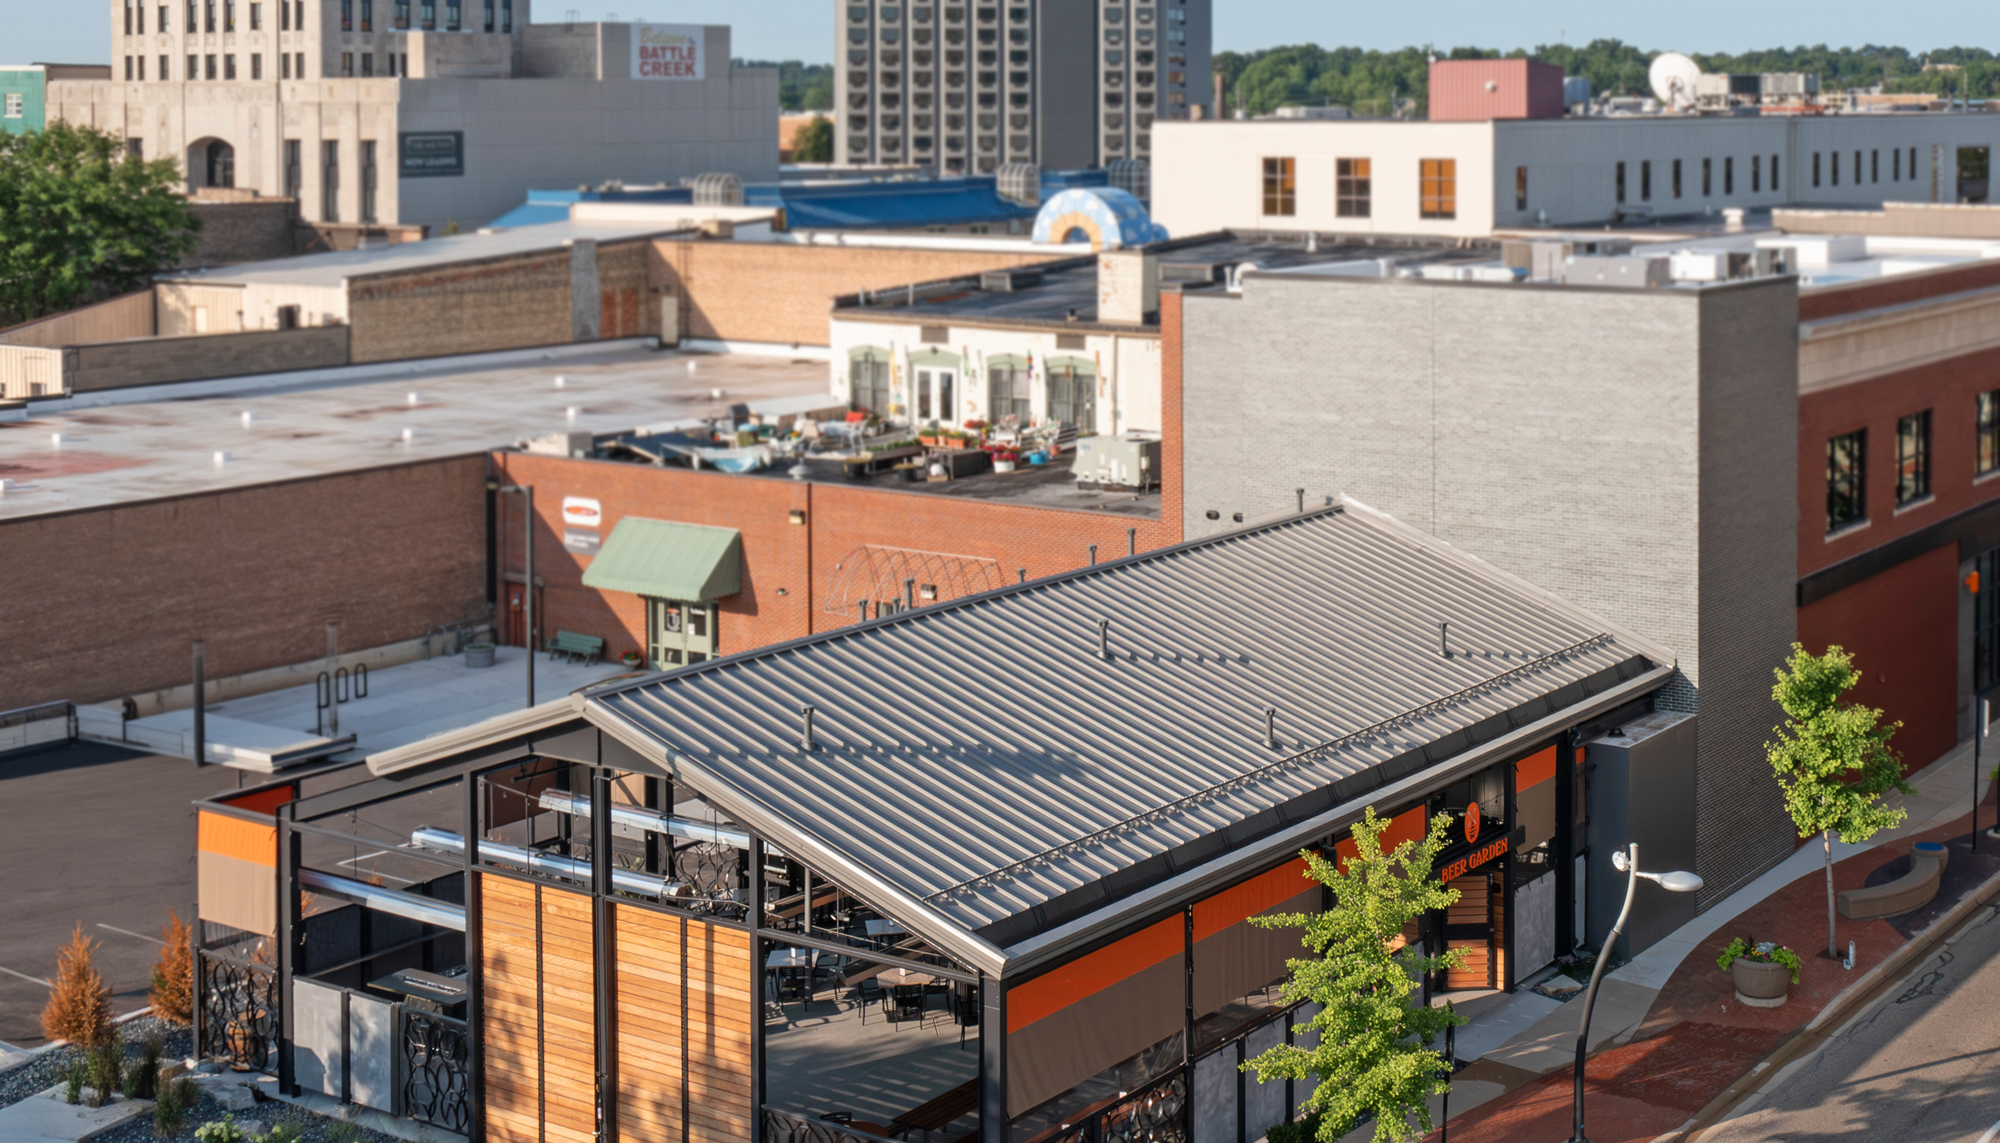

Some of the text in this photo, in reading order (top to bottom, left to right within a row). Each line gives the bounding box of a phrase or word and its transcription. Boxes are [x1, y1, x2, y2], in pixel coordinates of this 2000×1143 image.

[639, 46, 696, 60] BATTLE
[639, 60, 696, 77] CREEK
[1441, 837, 1508, 884] BEER GARDEN
